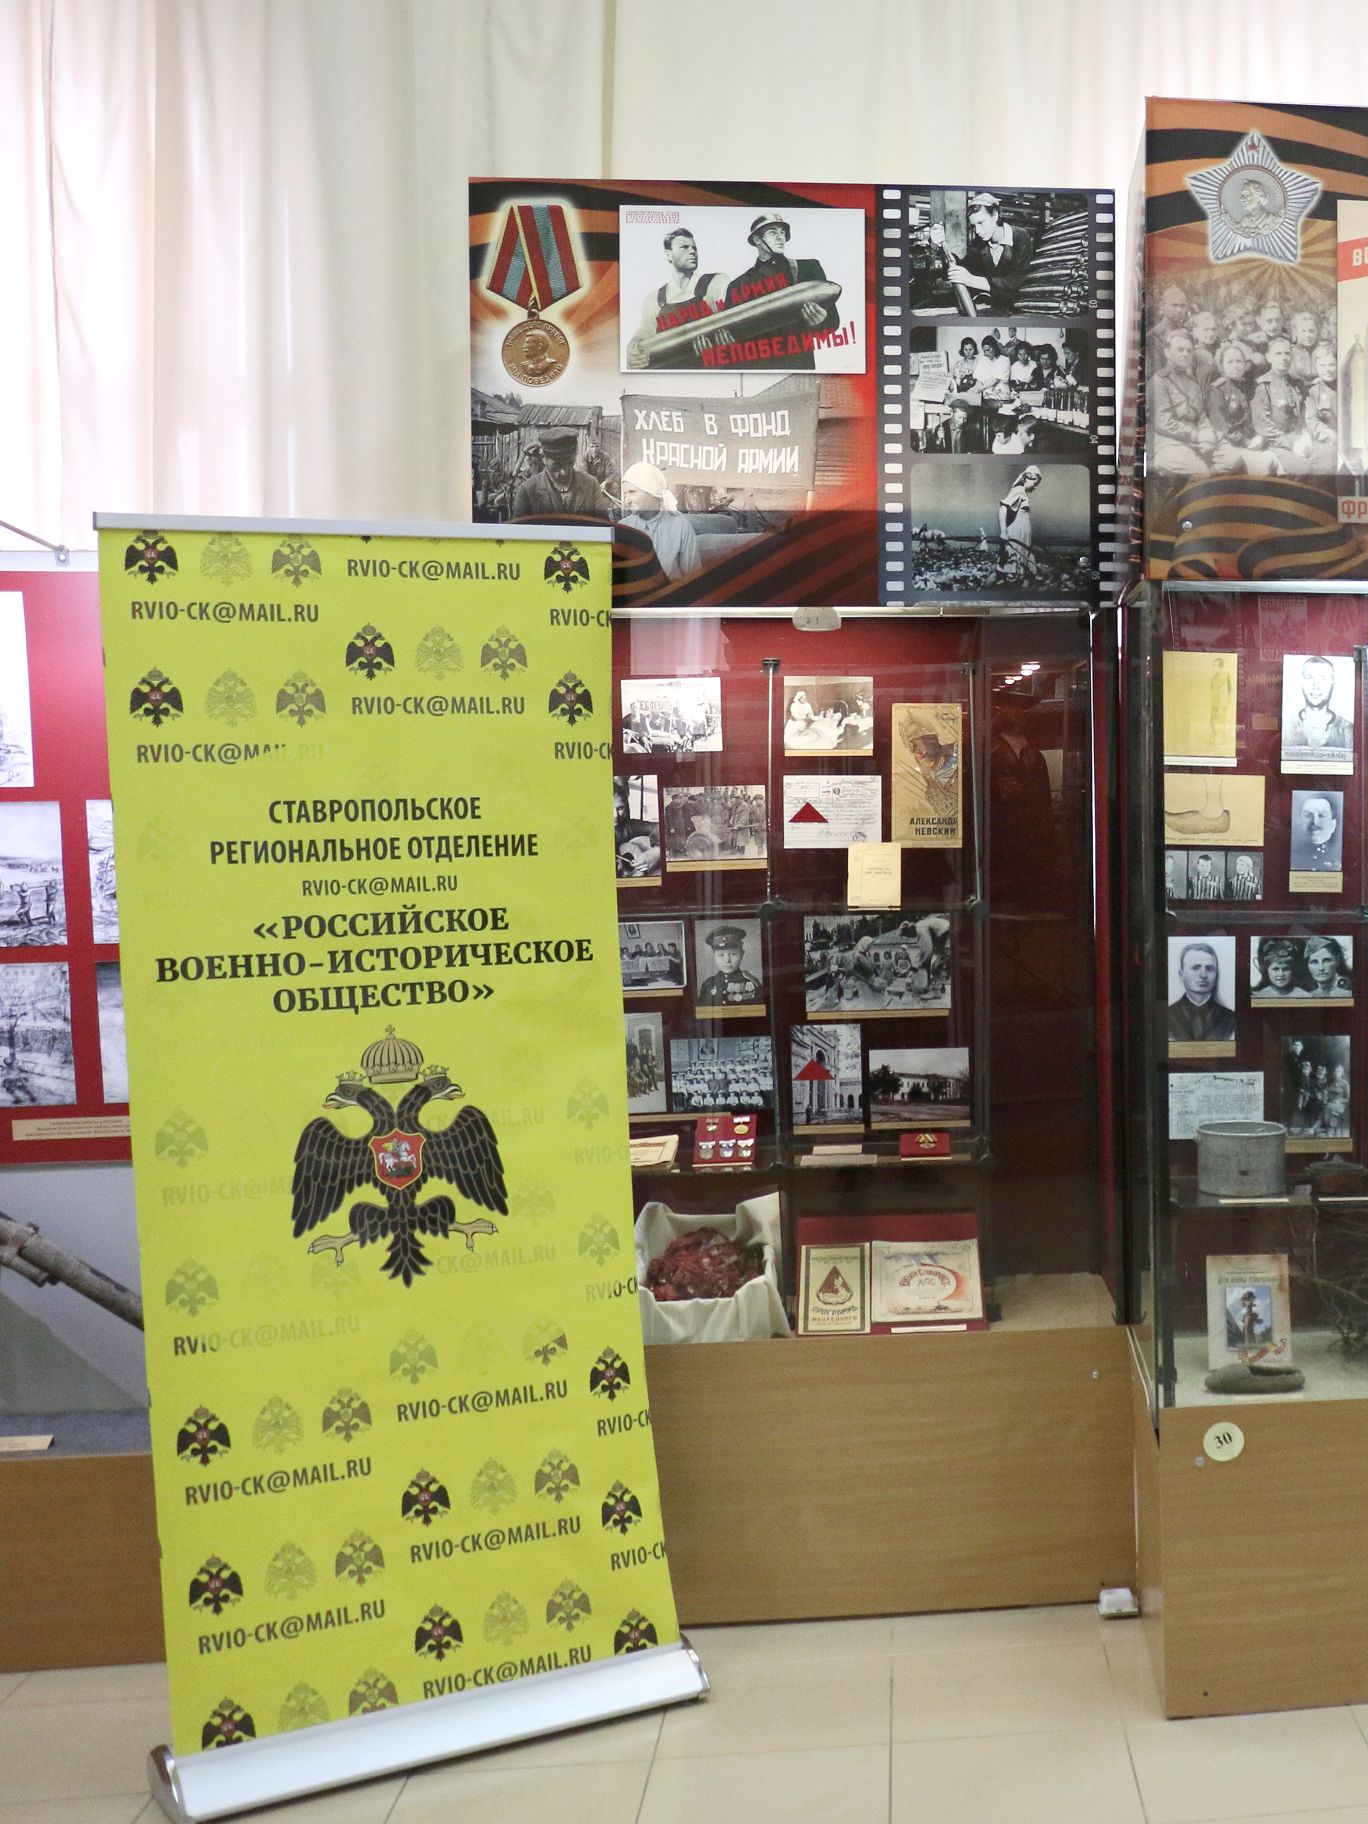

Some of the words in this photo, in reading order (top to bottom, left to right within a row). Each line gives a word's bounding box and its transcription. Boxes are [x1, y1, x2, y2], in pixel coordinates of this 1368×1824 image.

[656, 300, 713, 331] НАРОД
[731, 272, 790, 306] АРМИЯ
[702, 321, 857, 367] НЕПОБЕДИМЫ!
[634, 408, 684, 433] ХЛЕБ
[704, 413, 716, 435] В
[730, 410, 791, 438] ФОНД
[642, 438, 727, 472] КРАСНОЙ
[346, 559, 522, 581] RVIO-CK@MAIL.RU
[131, 601, 320, 624] RVIO-CK@MAIL.RU
[352, 695, 525, 717] RVIO-CK@MAIL.RU
[268, 796, 482, 824] СТАВРОПОЛЬСКОЕ
[209, 839, 401, 865] РЕГИОНАЛЬНОЕ
[407, 834, 538, 862] ОТДЕЛЕНИЕ
[302, 875, 458, 896] RVIO-CK@MAIL.RU
[253, 905, 510, 941] «РОССИЙСКОЕ
[155, 939, 594, 983] ВОЕННО-ИСТОРИЧЕСКОЕ
[273, 979, 495, 1014] ОБЩЕСТВО»
[173, 1315, 361, 1356] RVIO-CK@MAIL.RU
[397, 1380, 568, 1423] RVIO-CK@MAIL.RU
[1214, 1431, 1234, 1449] 30
[185, 1456, 373, 1505] RVIO-CK@MAIL.RU
[410, 1515, 581, 1563] RVIO-CK@MAIL.RU
[198, 1600, 386, 1655] RVIO-CK@MAIL.RU
[423, 1644, 592, 1699] RVIO-CK@MAIL.RU
